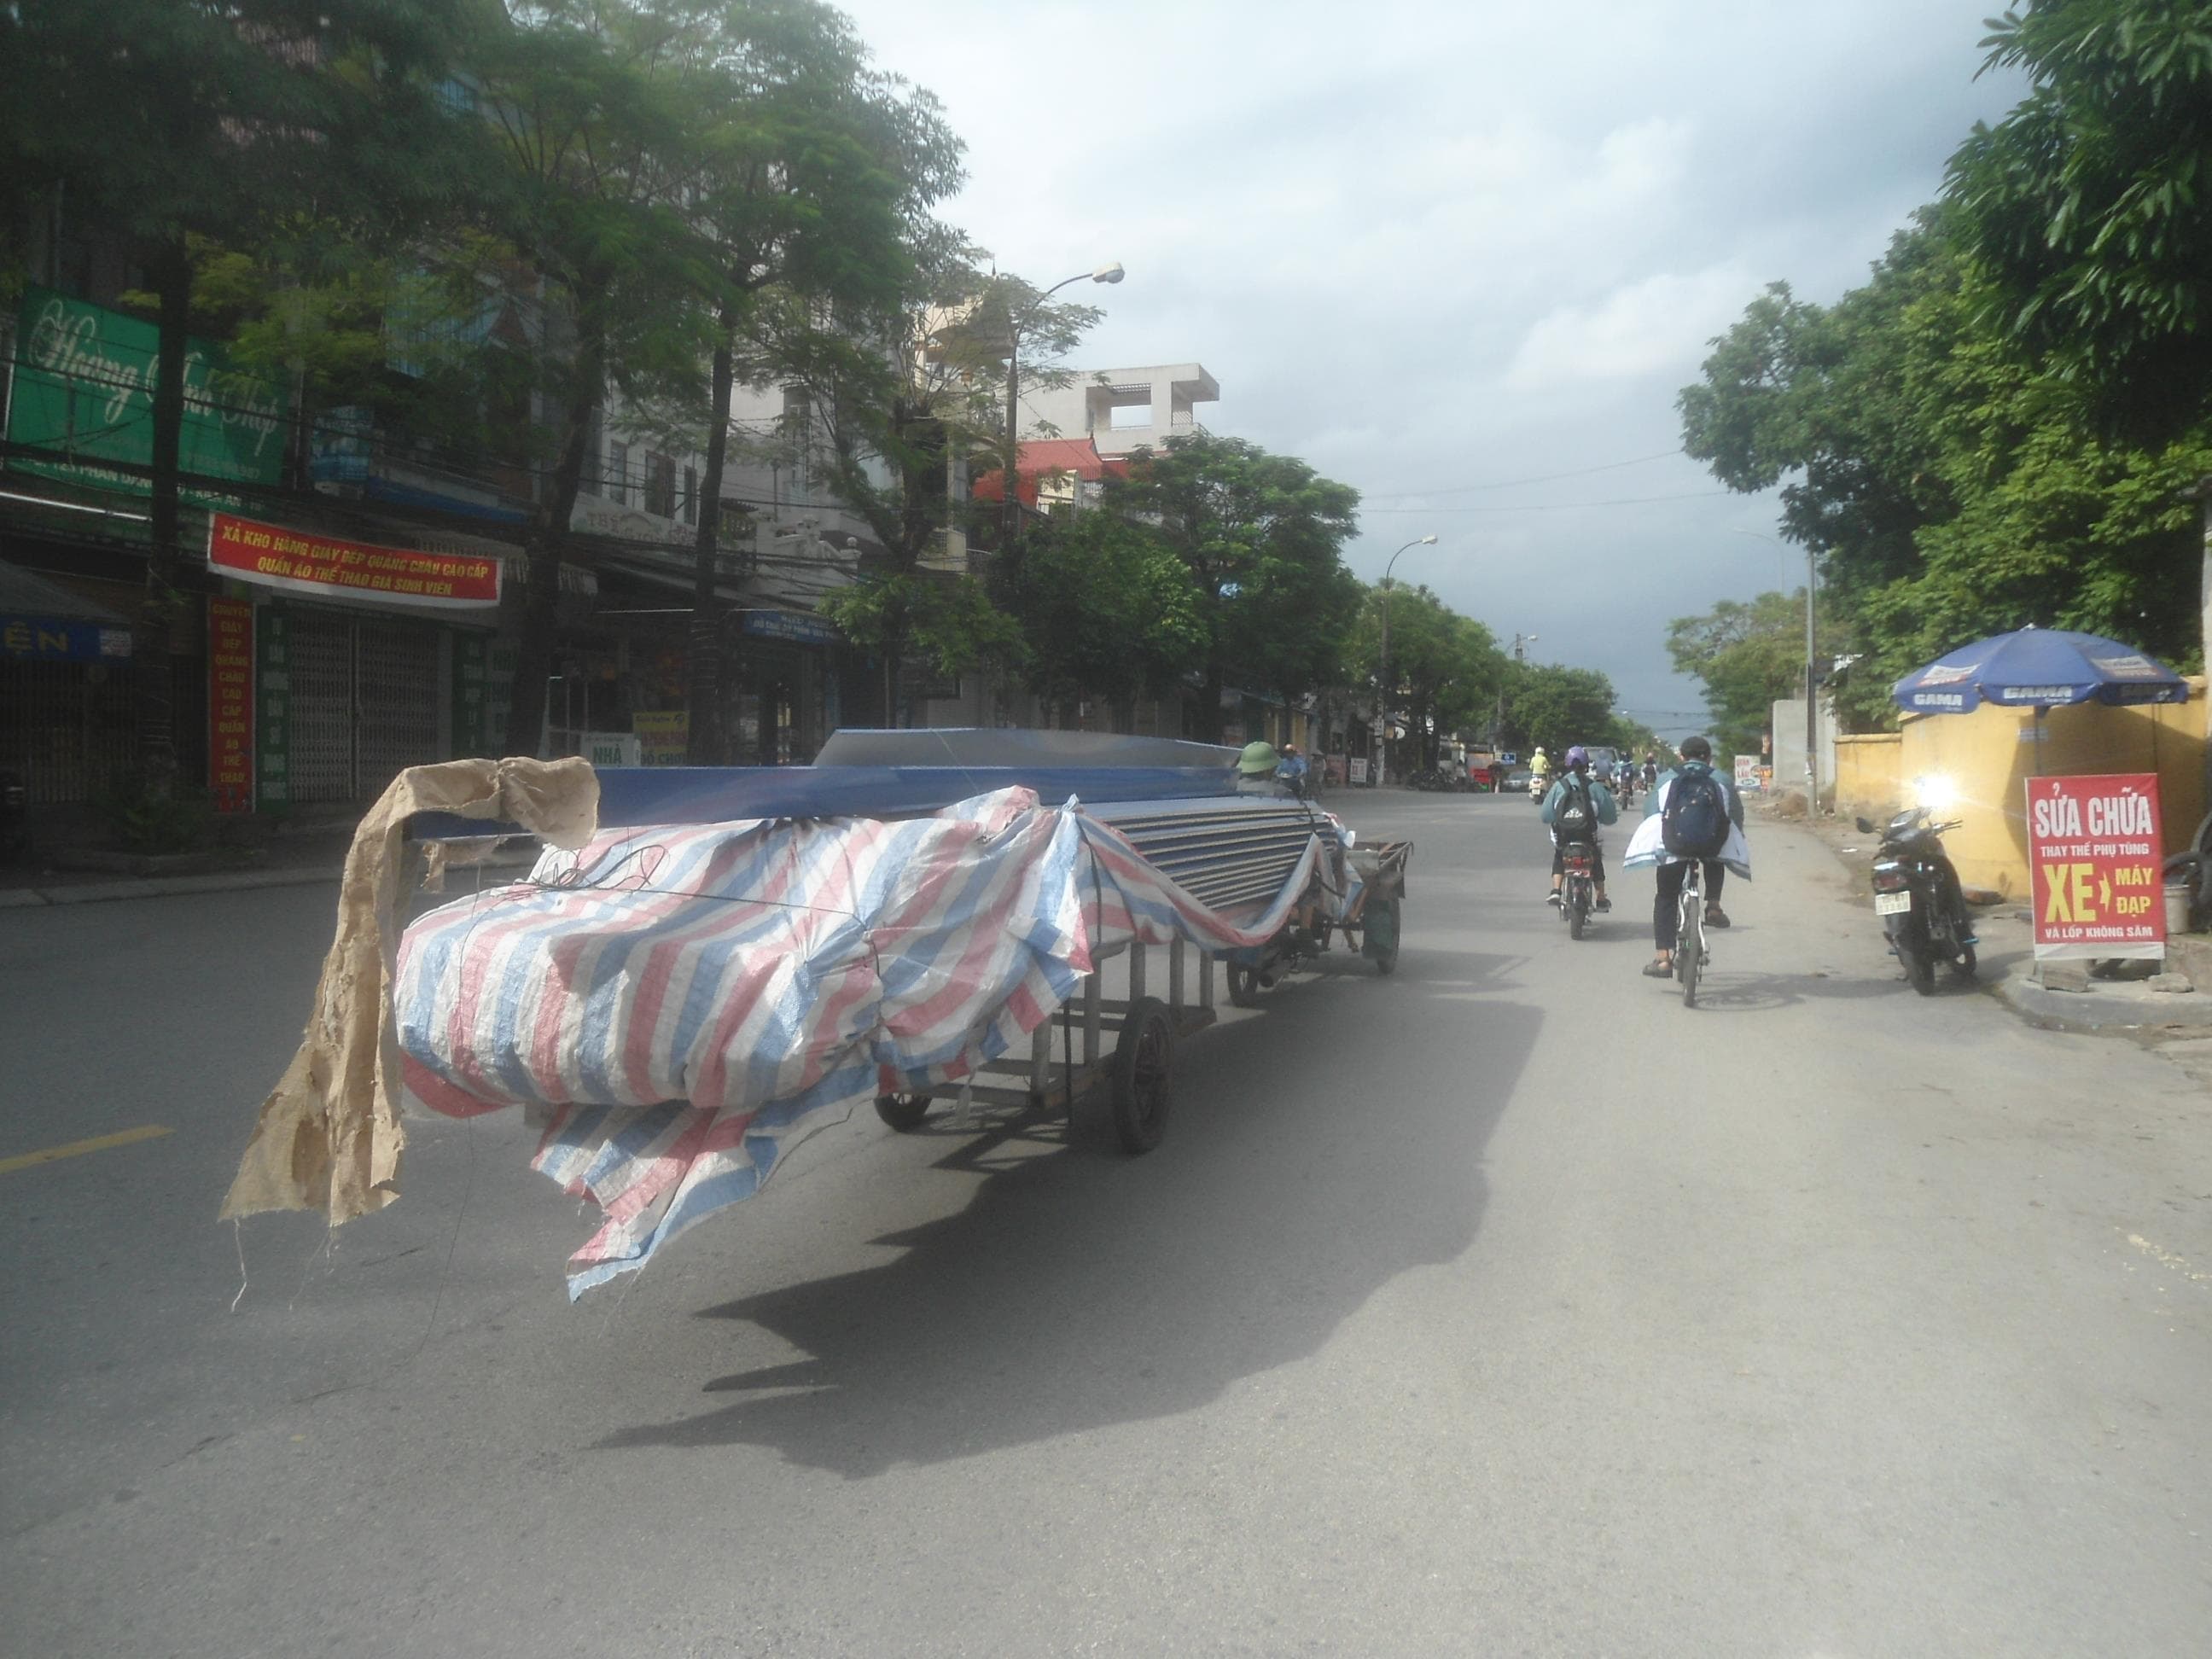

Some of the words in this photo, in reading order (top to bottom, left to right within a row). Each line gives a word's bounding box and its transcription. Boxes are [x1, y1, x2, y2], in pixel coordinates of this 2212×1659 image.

[243, 530, 270, 549] KHO
[273, 535, 308, 557] HÀNG
[442, 563, 465, 578] CAO
[294, 560, 312, 579] ÁO
[340, 569, 370, 586] THAO
[394, 578, 423, 593] SINH
[1913, 694, 1963, 706] GAMA
[2004, 685, 2073, 699] GAMA
[2034, 782, 2082, 838] SỬA
[2087, 787, 2154, 836] CHỮA
[2040, 846, 2068, 858] THAY
[2070, 841, 2091, 857] THẾ
[2093, 843, 2116, 859] PHỤ
[2118, 841, 2149, 856] TÙNG
[2115, 864, 2153, 886] MÁY
[2042, 863, 2097, 923] XE
[2116, 896, 2151, 918] ĐẠP
[2062, 924, 2083, 938] LỐP
[2086, 925, 2124, 938] KHÔNG
